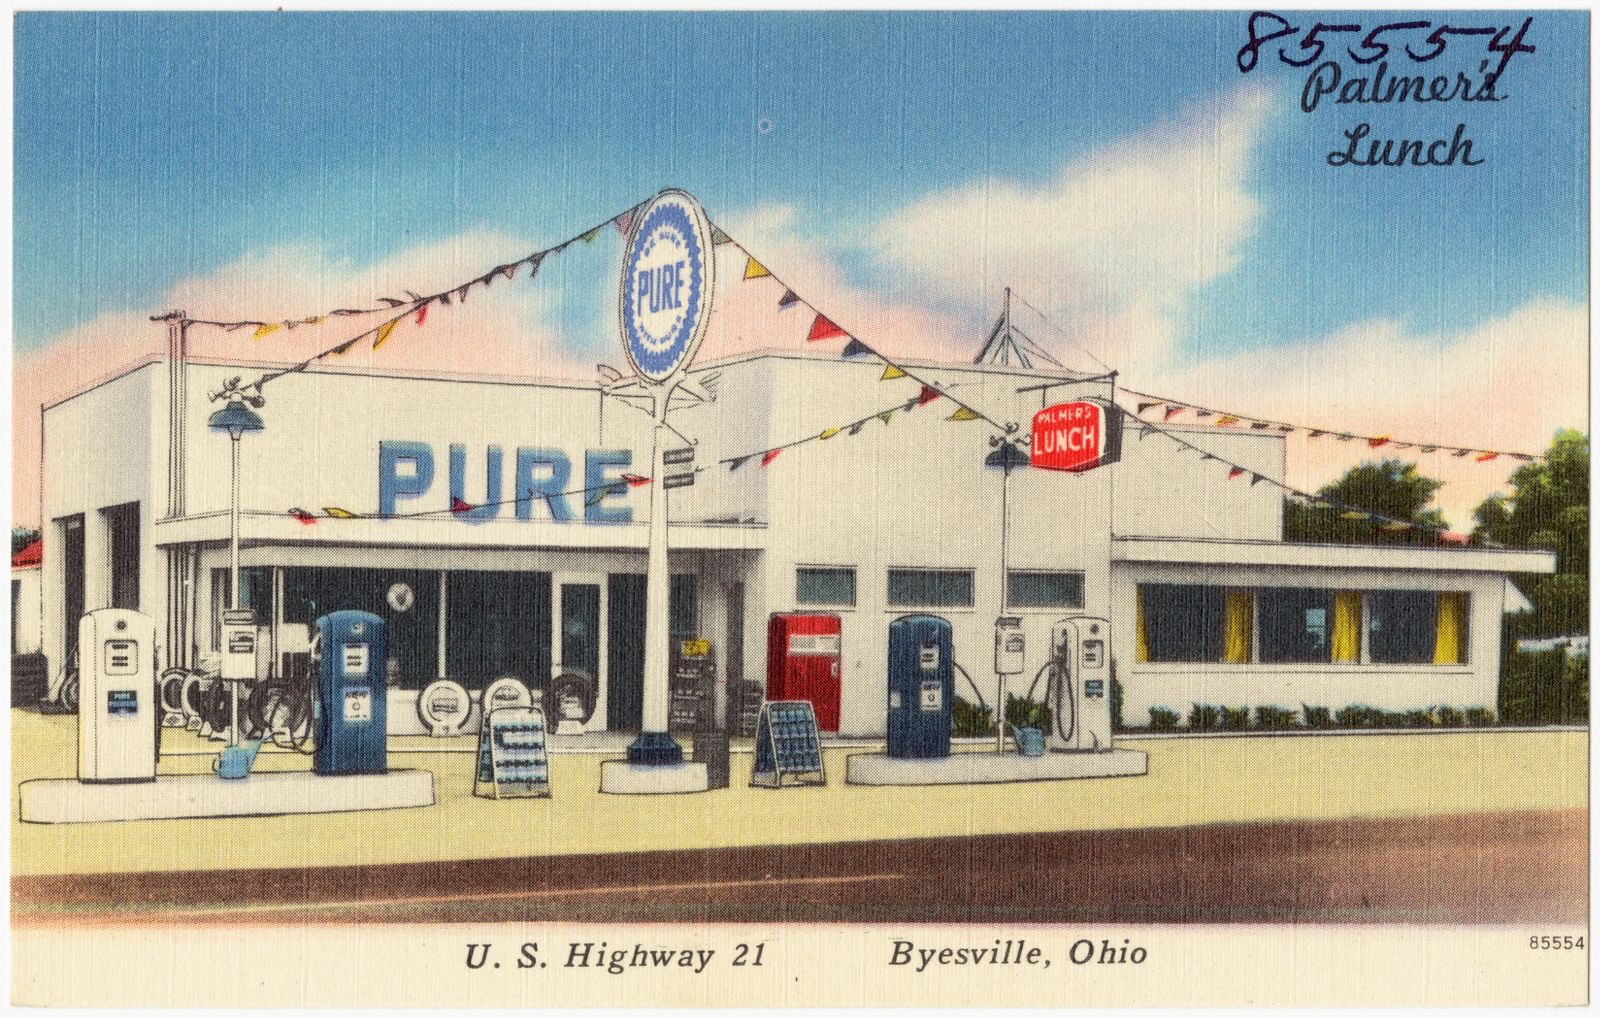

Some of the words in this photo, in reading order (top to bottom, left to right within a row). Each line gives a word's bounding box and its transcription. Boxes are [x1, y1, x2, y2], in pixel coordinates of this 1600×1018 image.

[1237, 11, 1536, 90] 85554
[638, 260, 685, 317] PURE
[1033, 425, 1096, 456] LUNCH
[378, 440, 633, 525] PURE
